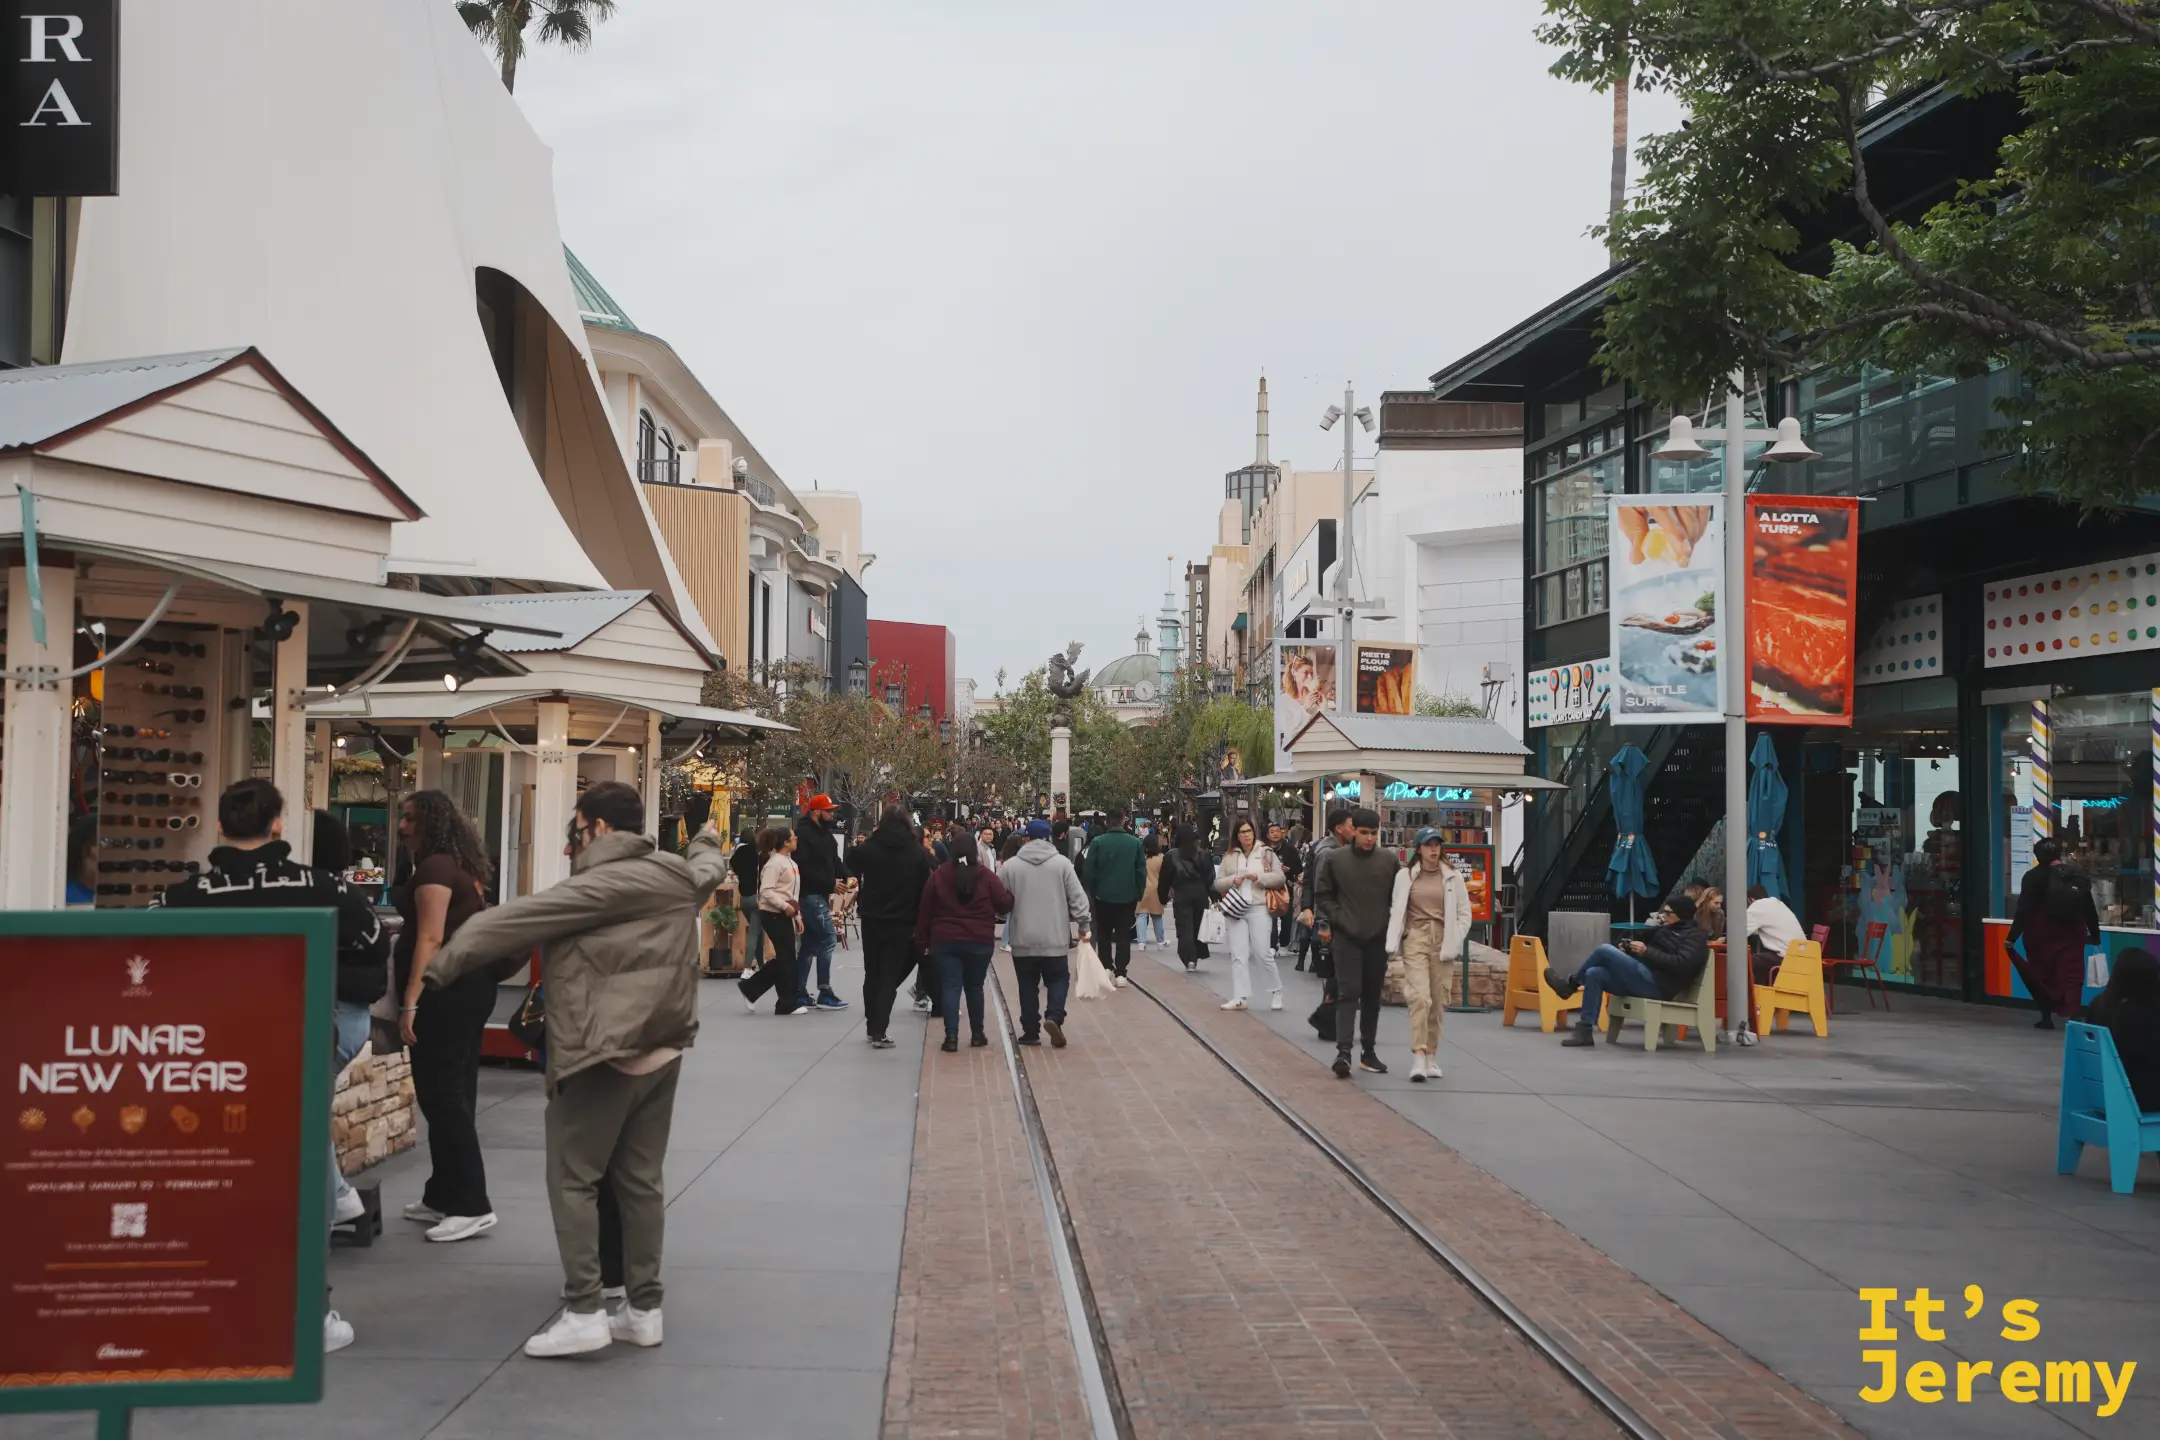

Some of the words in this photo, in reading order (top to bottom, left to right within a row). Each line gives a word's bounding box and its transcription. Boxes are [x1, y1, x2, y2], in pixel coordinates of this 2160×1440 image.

[1760, 512, 1771, 522] A
[1772, 513, 1820, 524] LOTTA
[1759, 524, 1802, 535] TURF.
[1195, 579, 1204, 665] BARNES
[1360, 651, 1391, 660] MEETS
[1360, 658, 1390, 666] FLOUR
[1360, 664, 1387, 673] SHOP.
[1624, 686, 1637, 696] A
[1639, 684, 1688, 695] ITTLE
[1625, 696, 1668, 707] SURF.
[1384, 781, 1431, 801] iPhoe
[64, 1024, 206, 1057] LUNAR
[18, 1062, 123, 1094] NEW
[137, 1060, 248, 1093] YEAR
